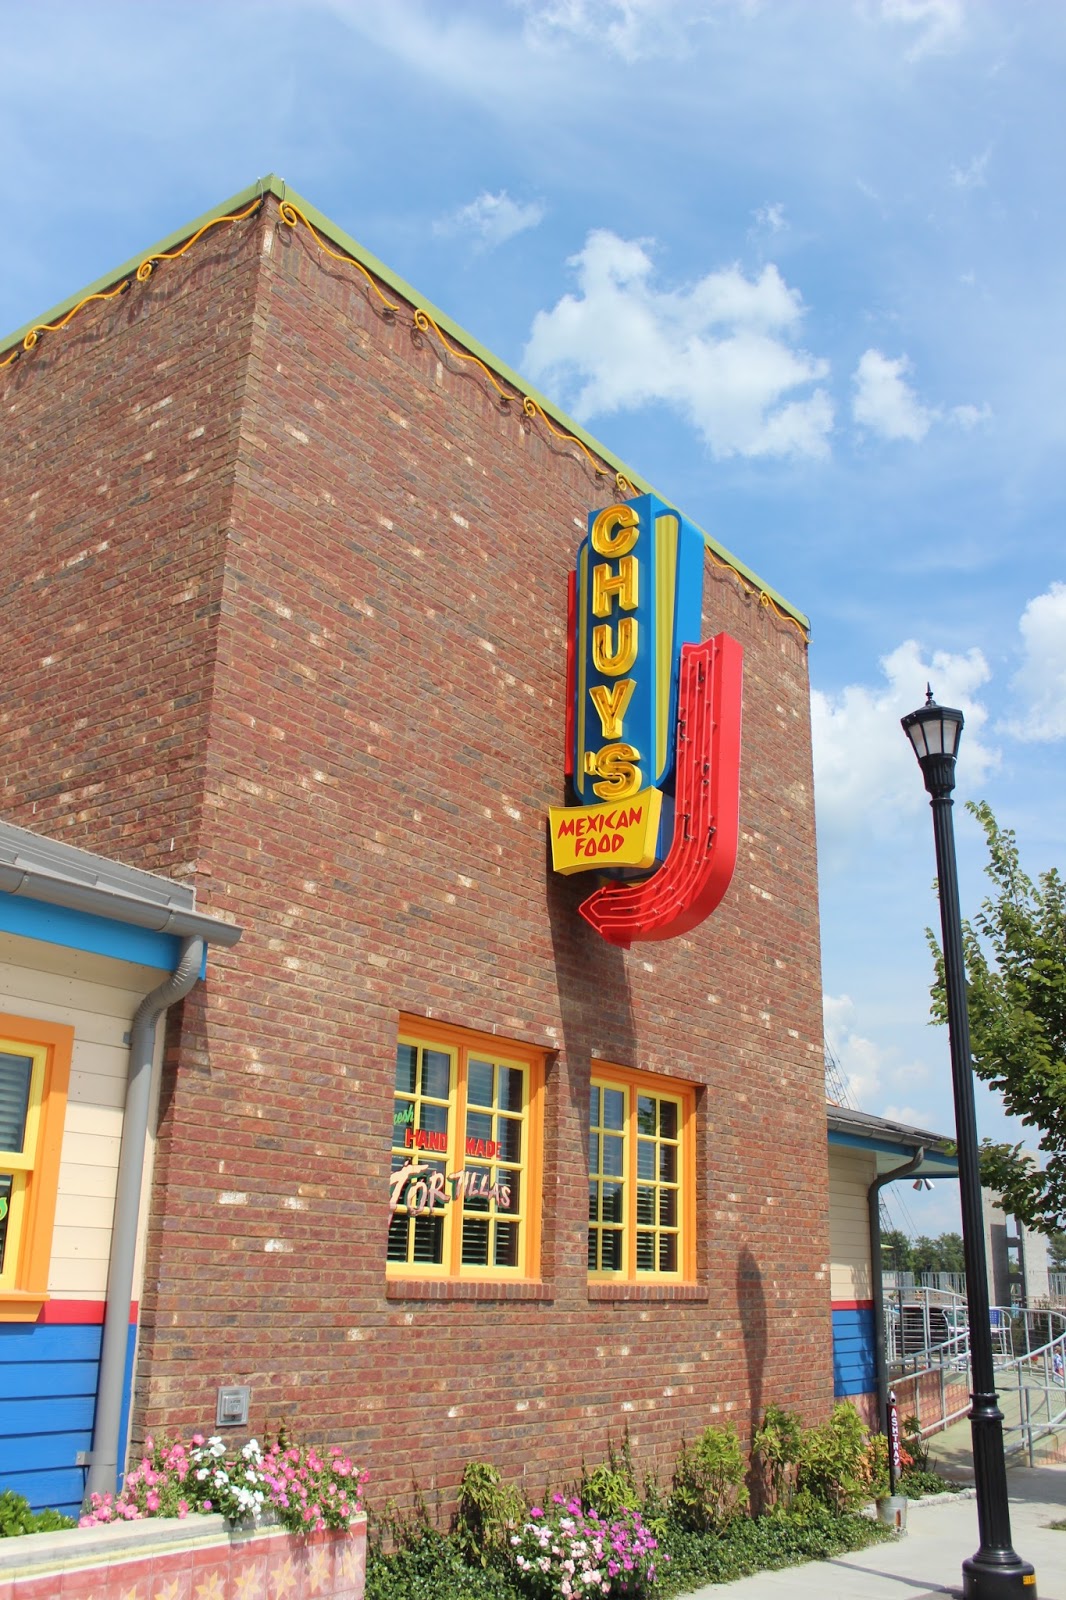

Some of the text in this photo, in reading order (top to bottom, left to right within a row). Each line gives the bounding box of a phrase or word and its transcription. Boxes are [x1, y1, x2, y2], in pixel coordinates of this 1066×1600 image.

[584, 503, 642, 801] CHUY'S
[557, 806, 642, 839] MEXICAN
[575, 834, 624, 857] FOOD
[388, 1159, 511, 1227] TORTILLAS
[890, 1407, 900, 1466] ASHTRAY
